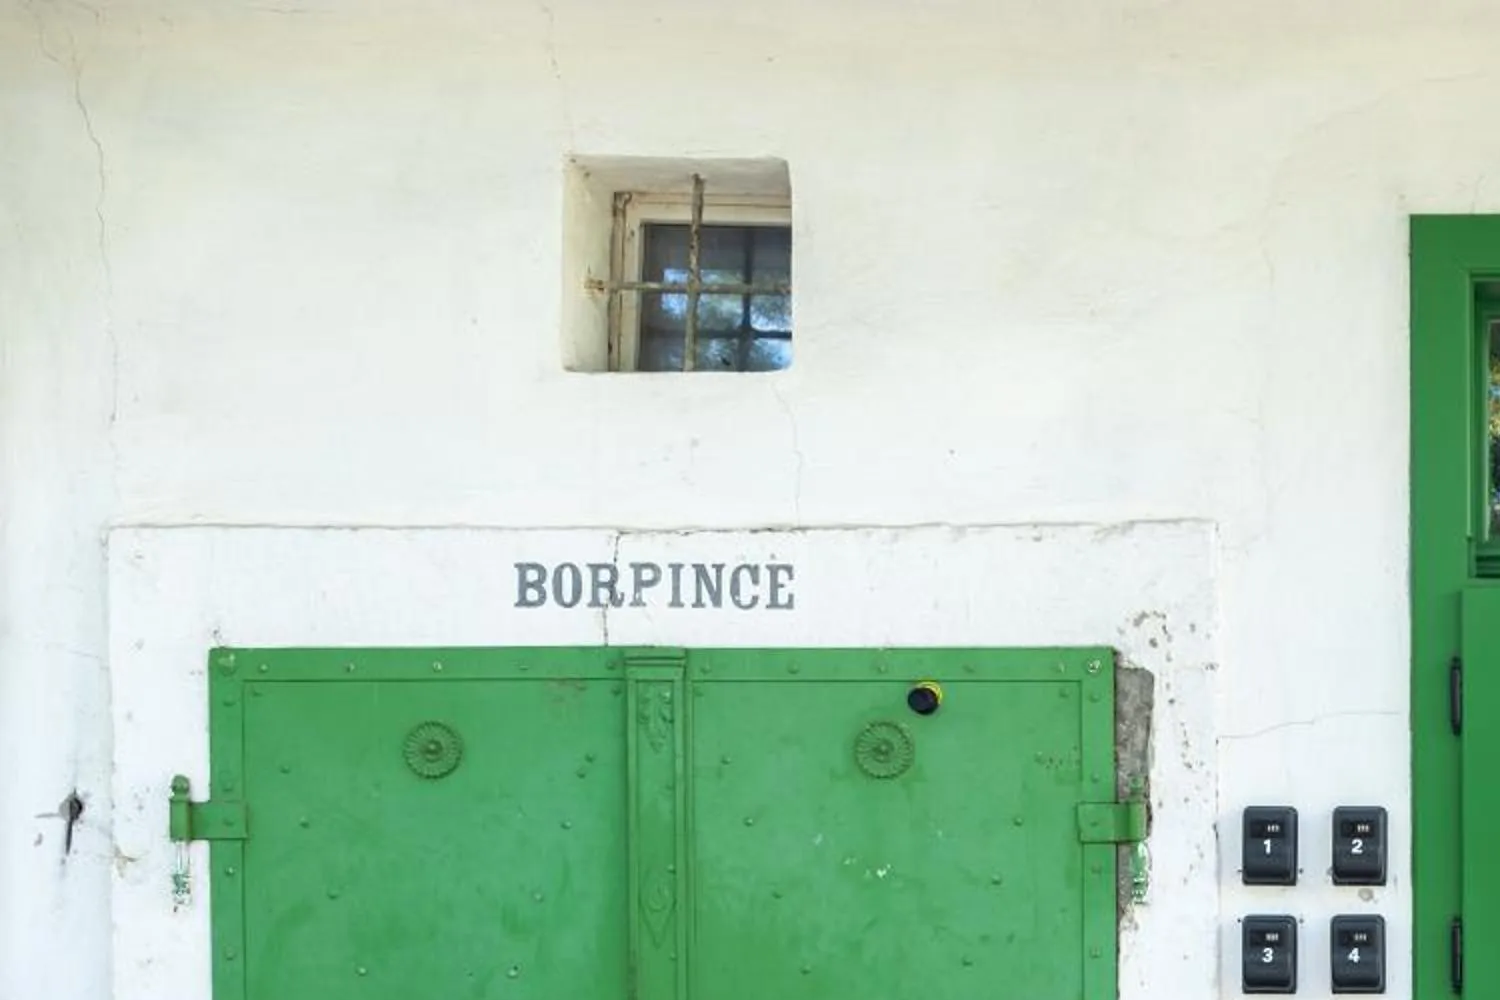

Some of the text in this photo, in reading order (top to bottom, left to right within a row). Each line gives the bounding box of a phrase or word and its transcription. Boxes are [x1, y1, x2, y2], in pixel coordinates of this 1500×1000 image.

[513, 562, 795, 610] BORPINCE
[1263, 838, 1272, 855] 1
[1351, 838, 1364, 855] 2
[1261, 947, 1274, 964] 3
[1347, 947, 1361, 964] 4
